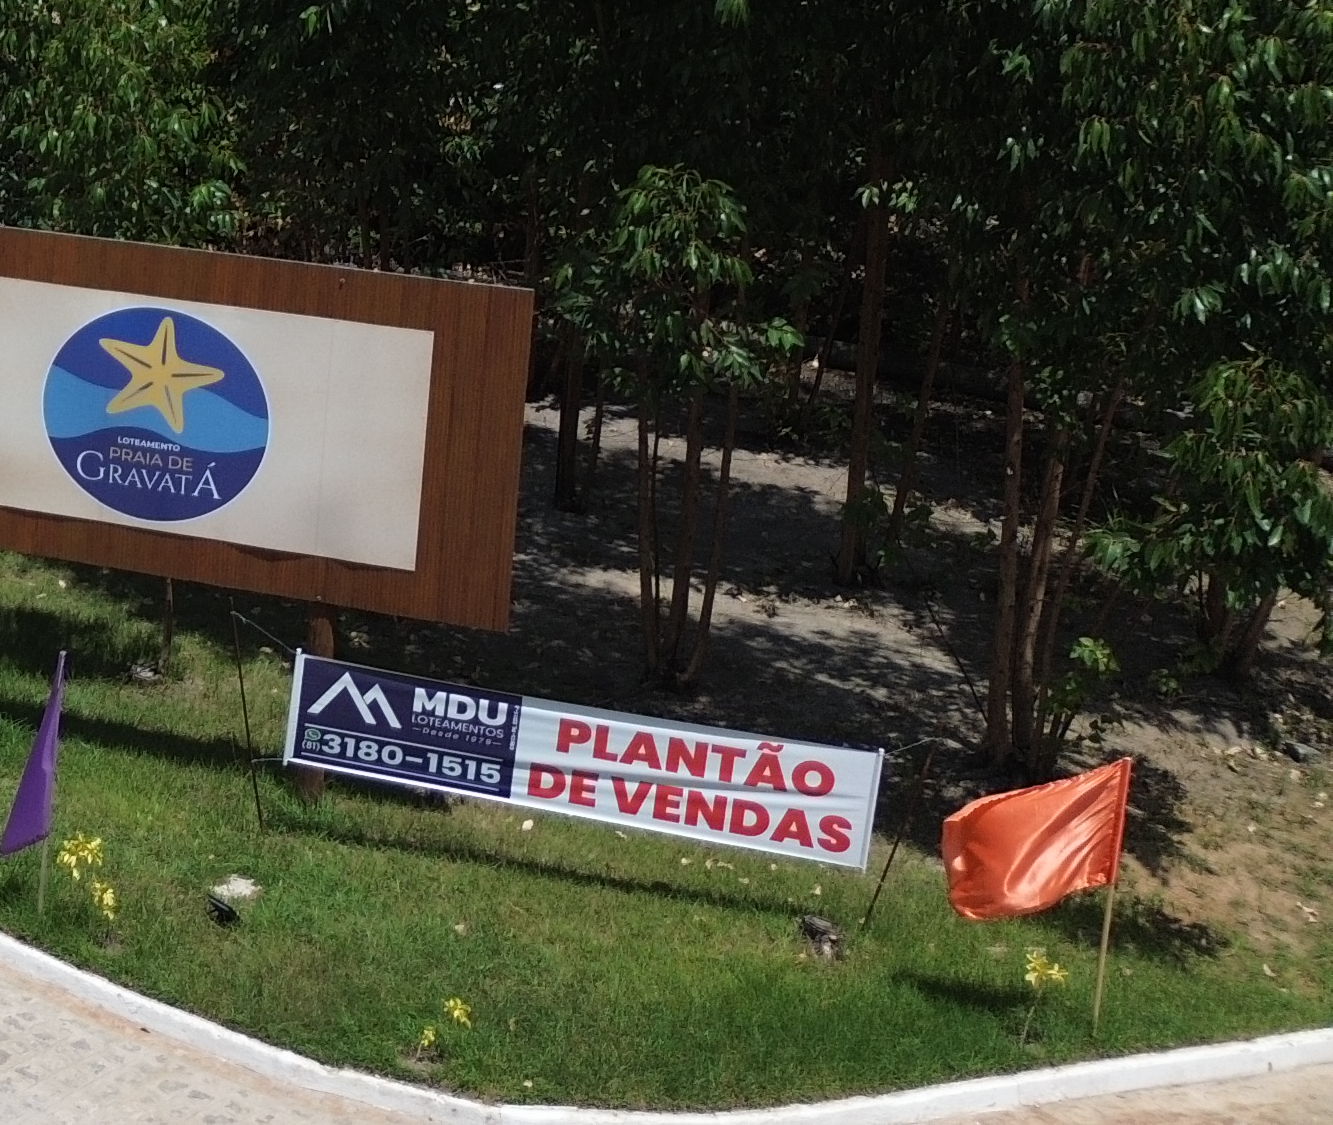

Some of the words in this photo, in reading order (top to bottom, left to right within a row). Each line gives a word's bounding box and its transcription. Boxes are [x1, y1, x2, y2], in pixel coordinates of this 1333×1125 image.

[109, 446, 163, 467] PRAIA
[168, 455, 193, 472] DE
[118, 436, 180, 452] LOTEAMENTO
[76, 450, 222, 500] GRAVATÁ
[411, 713, 504, 739] LOTEAMENTOS
[412, 687, 509, 726] MDU
[301, 738, 321, 752] (81)
[321, 733, 501, 784] 3180-1515
[556, 717, 835, 798] PLANTÃO
[526, 762, 600, 808] DE
[611, 776, 853, 854] VENDAS
